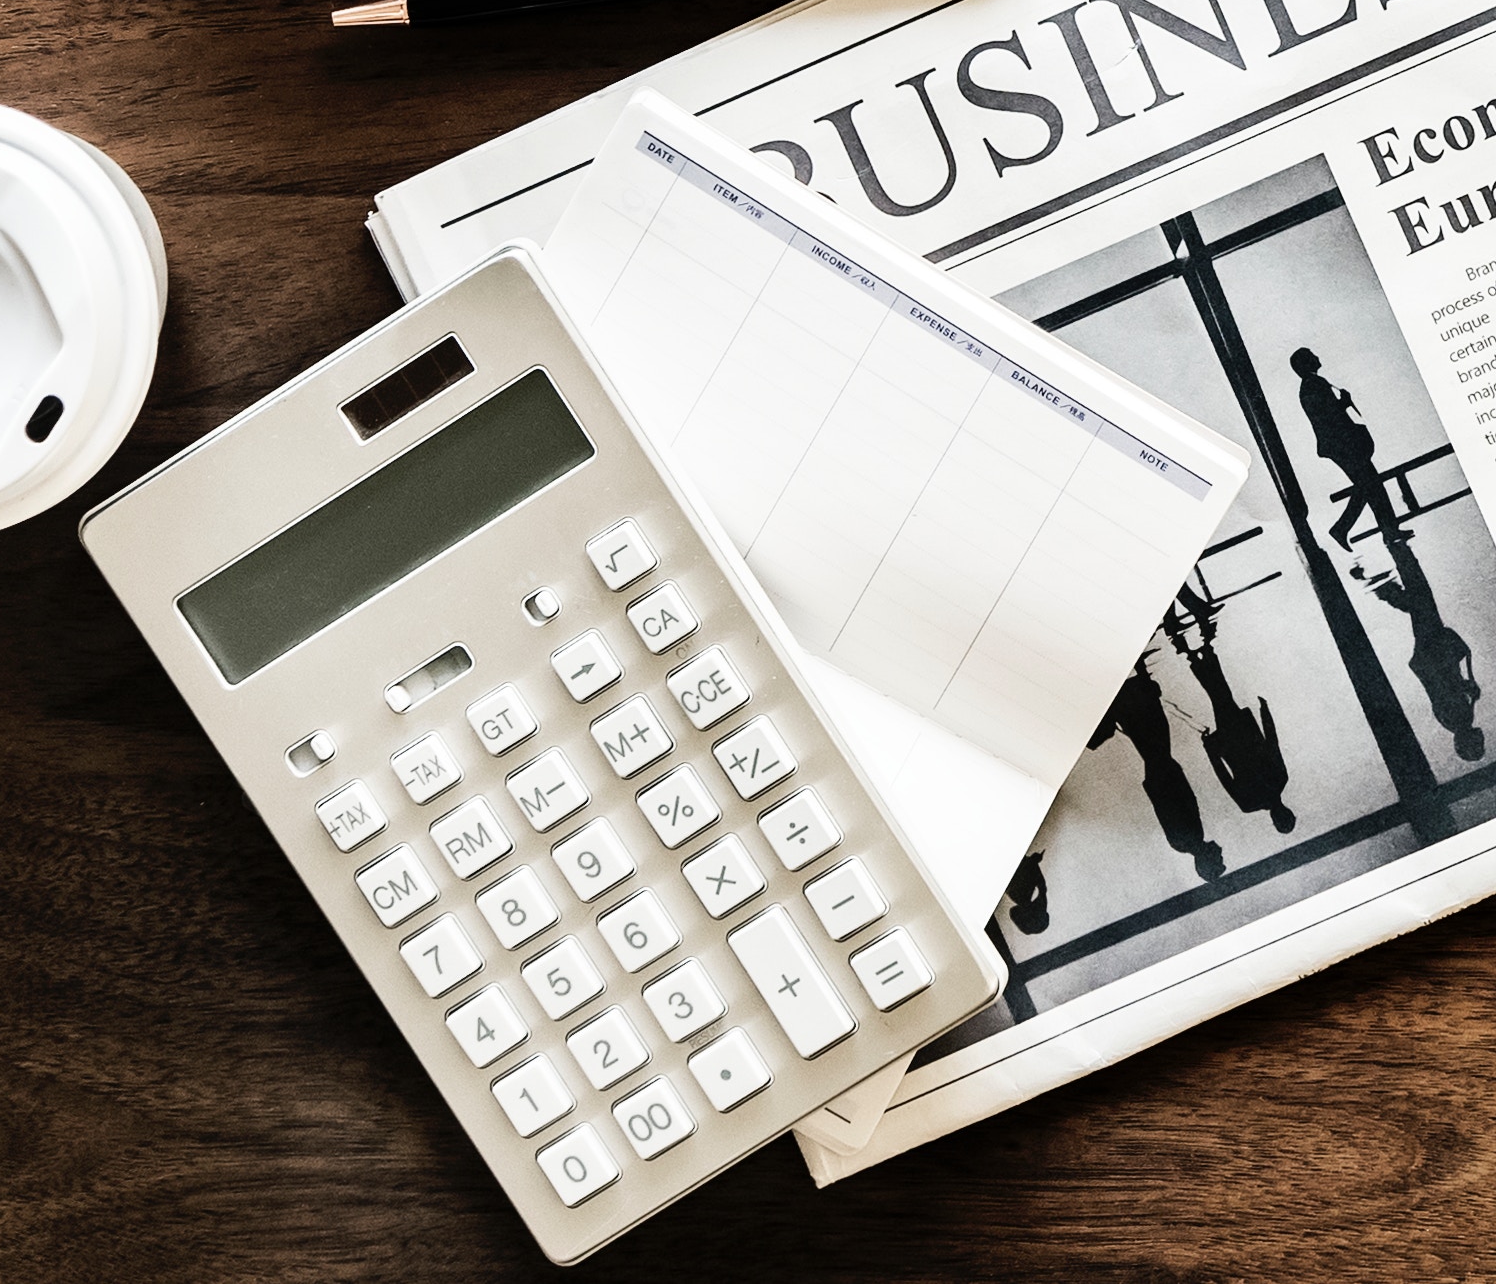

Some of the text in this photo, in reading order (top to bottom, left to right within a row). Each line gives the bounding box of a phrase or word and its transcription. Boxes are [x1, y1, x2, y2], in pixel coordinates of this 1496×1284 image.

[647, 142, 675, 164] DATE
[713, 183, 739, 204] ITEM
[811, 245, 852, 275] INCOME
[909, 307, 957, 342] EXPENSE
[1011, 370, 1061, 406] BALANCE
[1139, 449, 1169, 472] NOTE
[642, 608, 679, 637] CA
[481, 708, 513, 740] GT
[603, 723, 650, 769] M+
[319, 802, 371, 848] +TAX
[445, 822, 493, 864] RM
[373, 870, 418, 920] CM
[628, 1103, 672, 1142] 00
